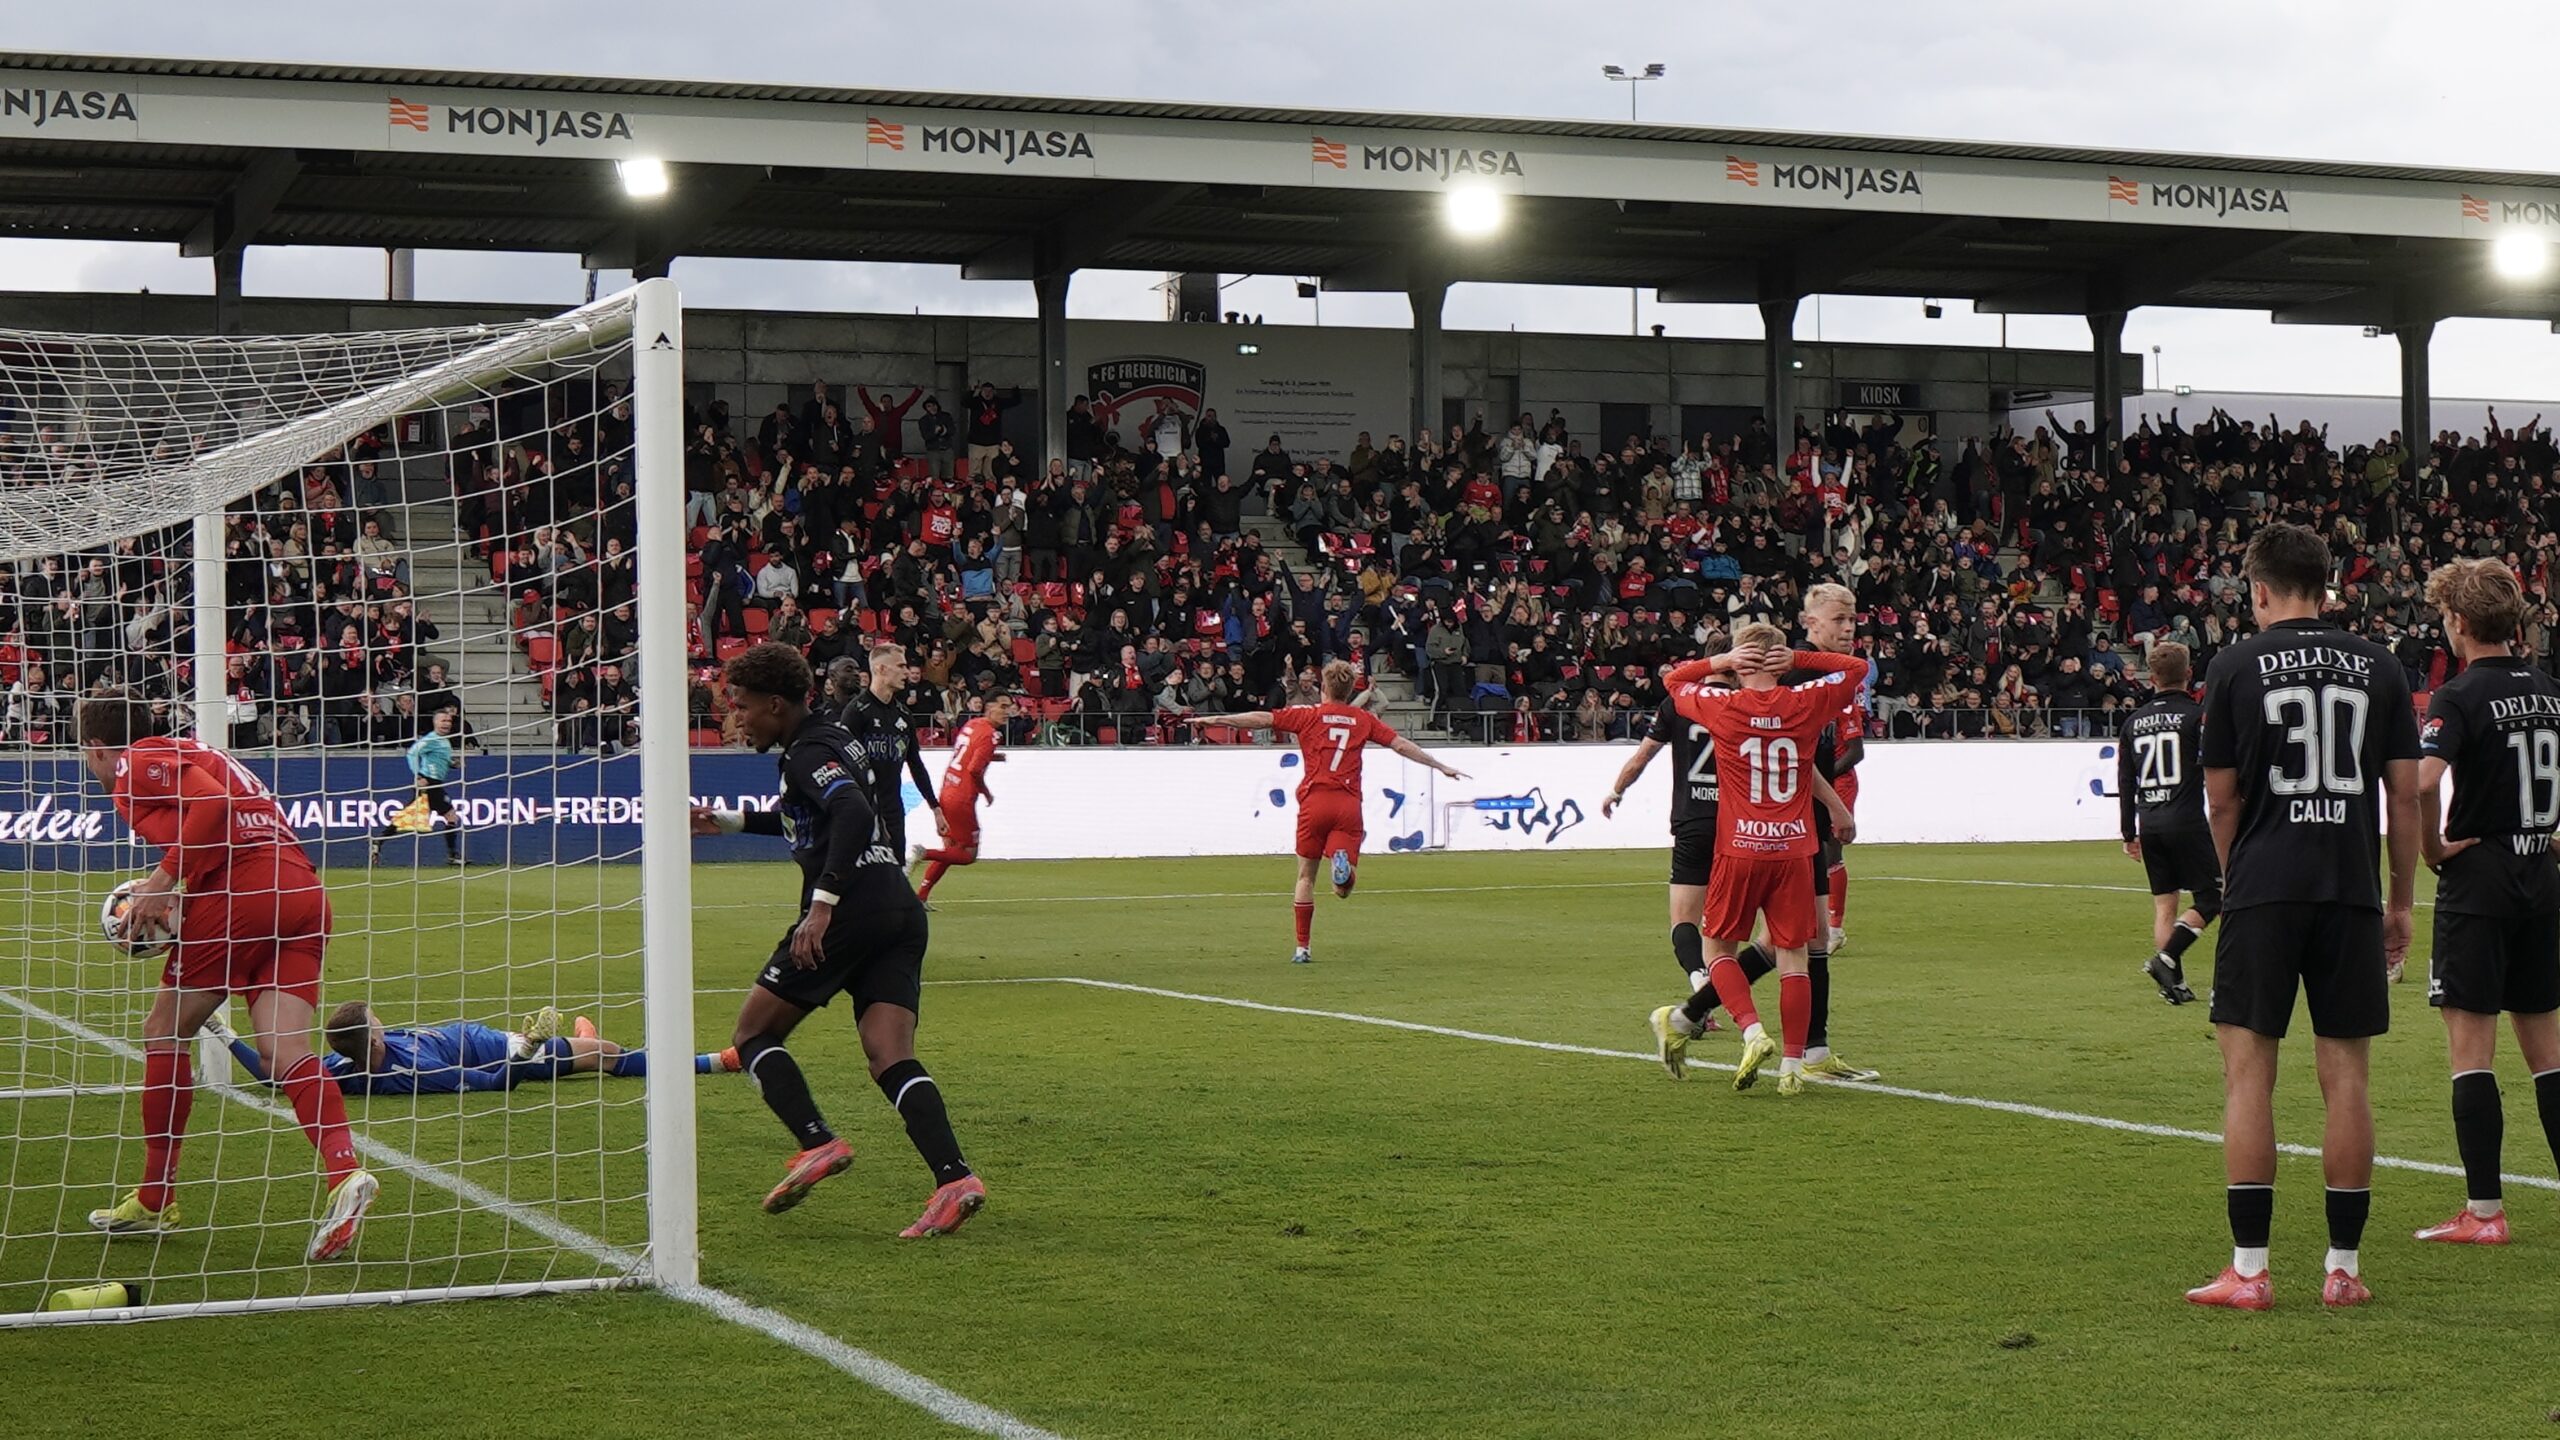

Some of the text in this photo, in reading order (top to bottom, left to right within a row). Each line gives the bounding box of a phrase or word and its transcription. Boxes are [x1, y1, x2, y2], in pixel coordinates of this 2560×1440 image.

[0, 88, 137, 127] NJASA
[448, 106, 630, 146] MONJASA
[922, 125, 1094, 165] MONJASA
[1363, 145, 1524, 182] MONJASA
[1773, 163, 1922, 200] MONJASA
[2152, 183, 2289, 218] MONJASA
[1100, 363, 1188, 384] FC FREDERICIA
[1860, 386, 1901, 405] KIOSK
[2257, 646, 2371, 675] DELUXE
[1328, 727, 1351, 773] 7
[2133, 731, 2182, 788] 20
[2263, 684, 2370, 796] 30
[1739, 737, 1799, 804] 10
[2506, 728, 2560, 829] 19
[2289, 799, 2347, 824] CALLØ
